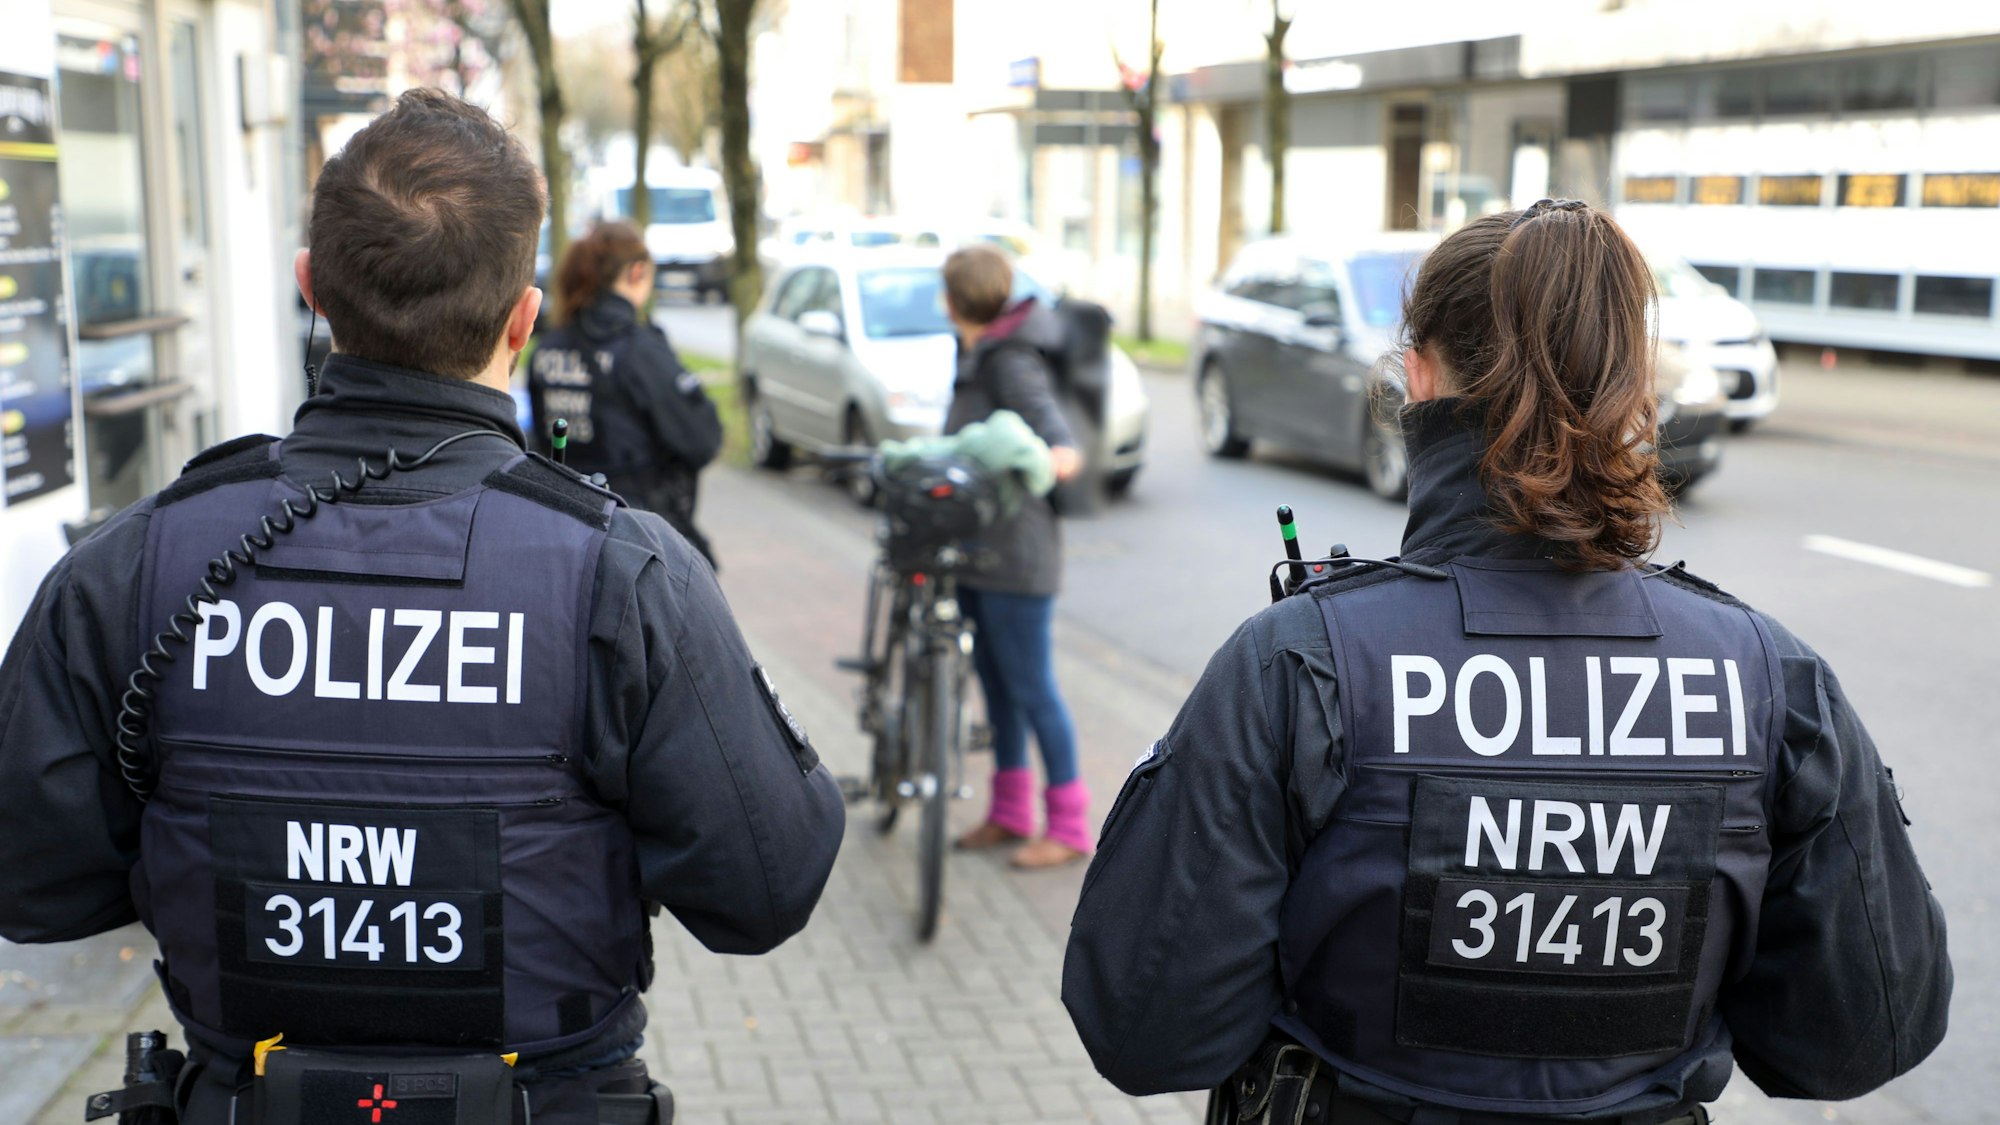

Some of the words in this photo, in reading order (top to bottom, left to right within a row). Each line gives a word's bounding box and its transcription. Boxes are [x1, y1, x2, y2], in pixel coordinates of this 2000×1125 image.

[192, 599, 525, 705] POLIZEI
[1390, 653, 1747, 757] POLIZEI
[286, 820, 417, 886] NRW
[1464, 795, 1672, 875] NRW
[264, 894, 464, 963] 31413
[1451, 889, 1667, 967] 31413
